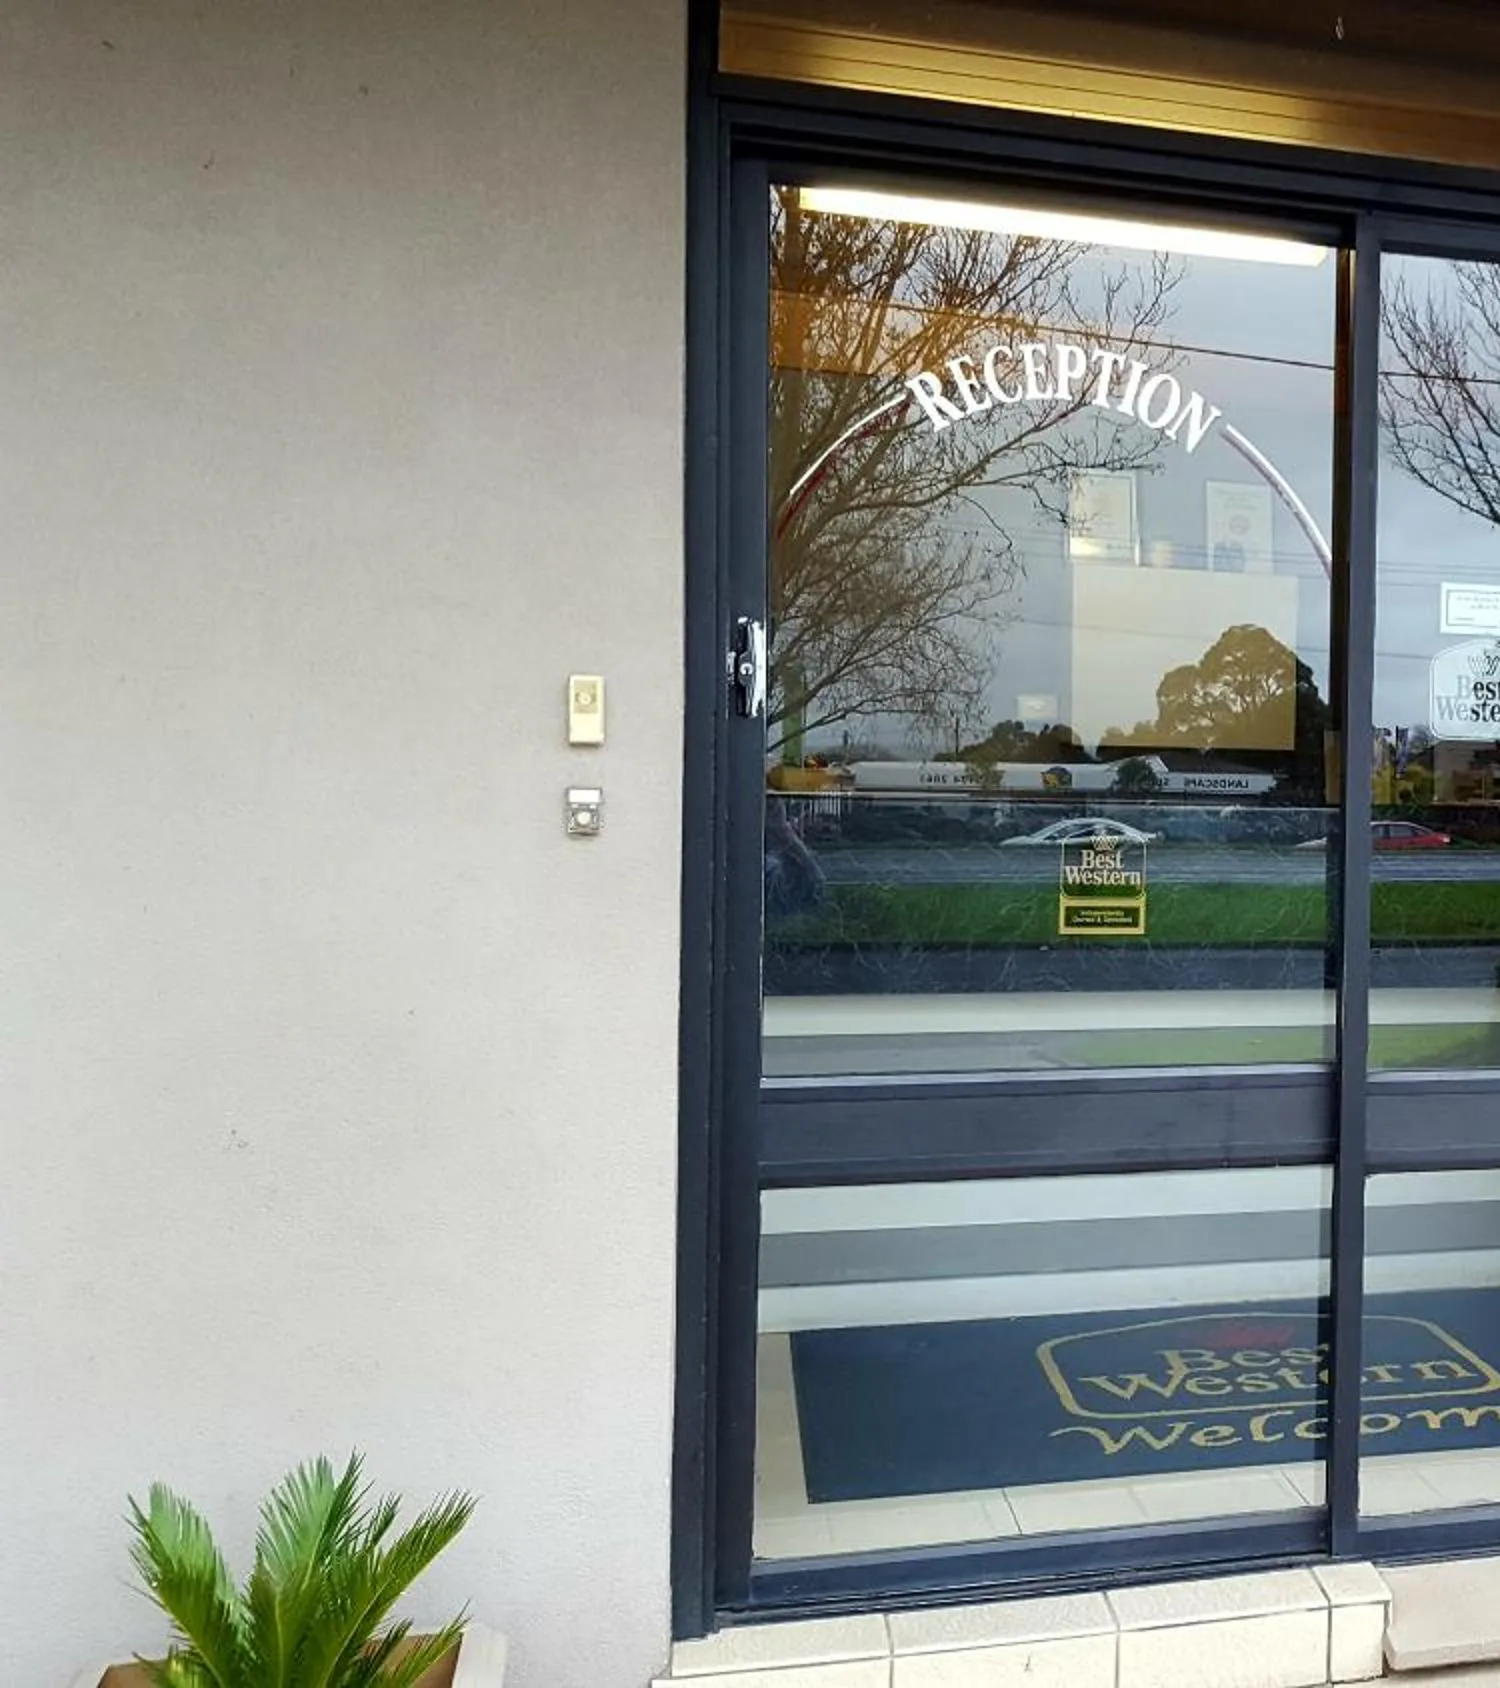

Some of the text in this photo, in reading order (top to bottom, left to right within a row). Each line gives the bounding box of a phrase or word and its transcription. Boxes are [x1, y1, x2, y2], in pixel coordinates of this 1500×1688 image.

[905, 343, 1221, 454] RECEPTION
[1081, 849, 1125, 869] Best
[1064, 865, 1141, 885] Western
[1159, 1343, 1330, 1377] Bes
